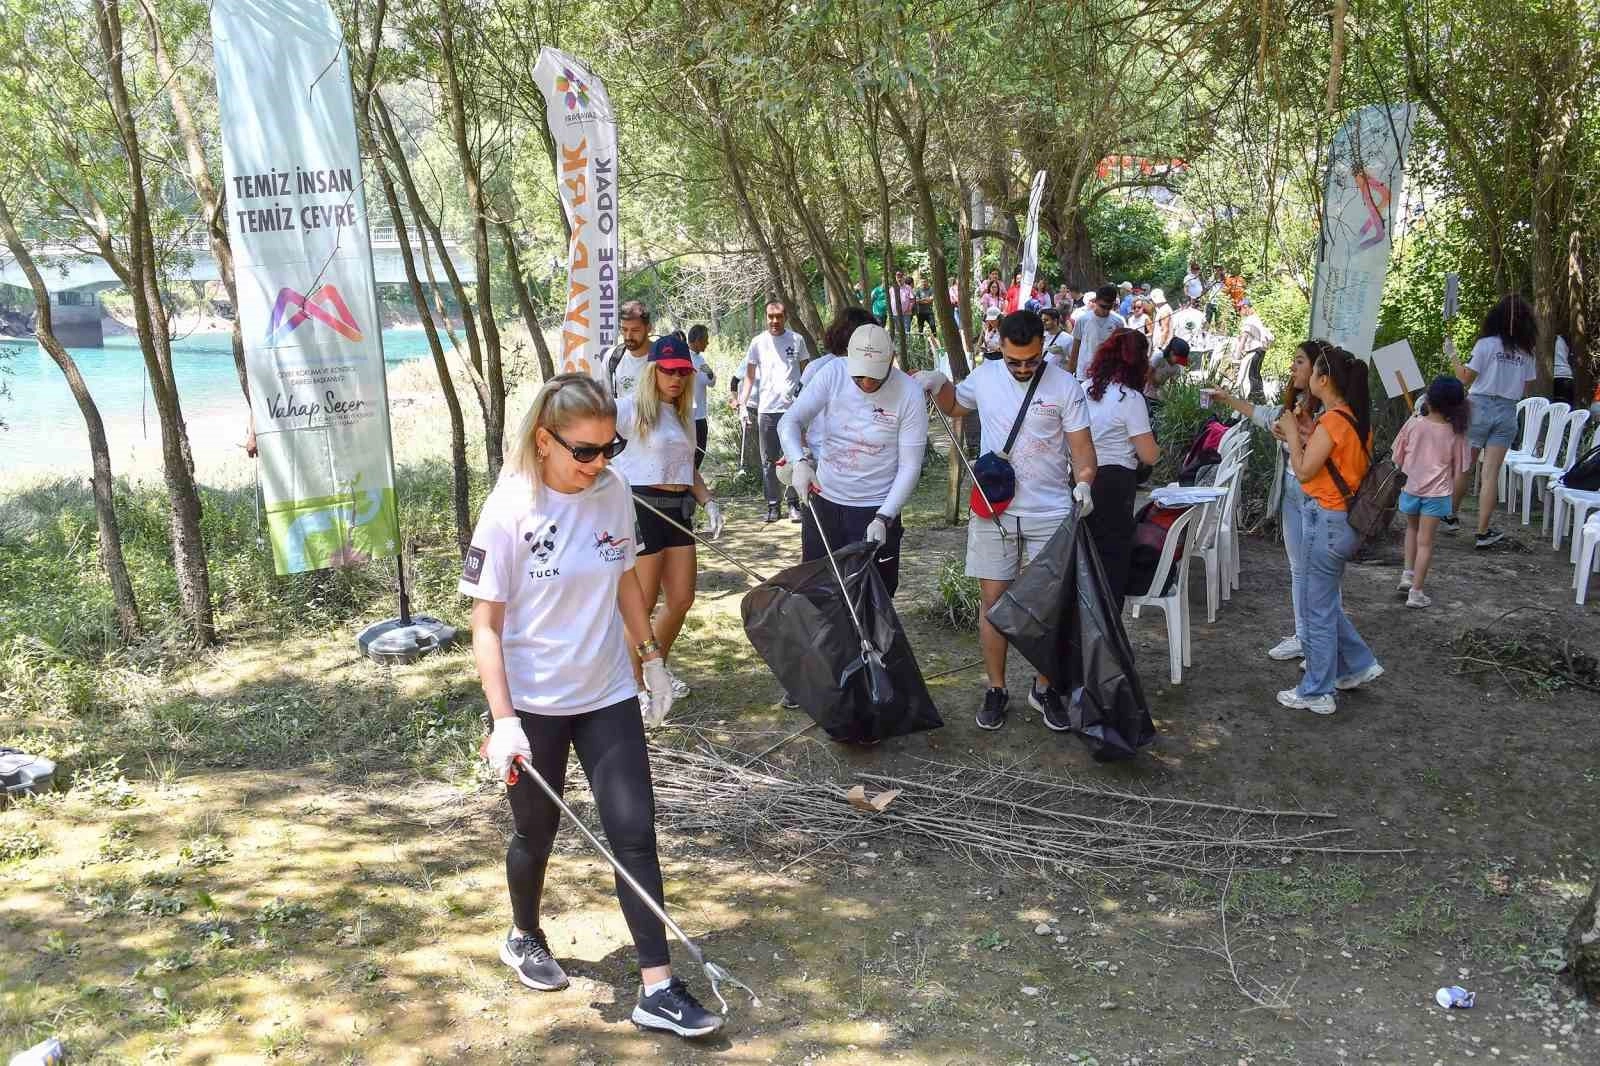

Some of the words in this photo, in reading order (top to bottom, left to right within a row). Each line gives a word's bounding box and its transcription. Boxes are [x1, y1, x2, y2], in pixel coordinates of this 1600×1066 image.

[233, 167, 291, 199] TEMİZ
[296, 166, 353, 195] İNSAN
[236, 202, 295, 233] TEMİZ
[300, 203, 357, 234] ÇEVRE
[266, 393, 320, 426] Vahap
[324, 390, 365, 414] Seçer
[529, 567, 560, 579] TUCK
